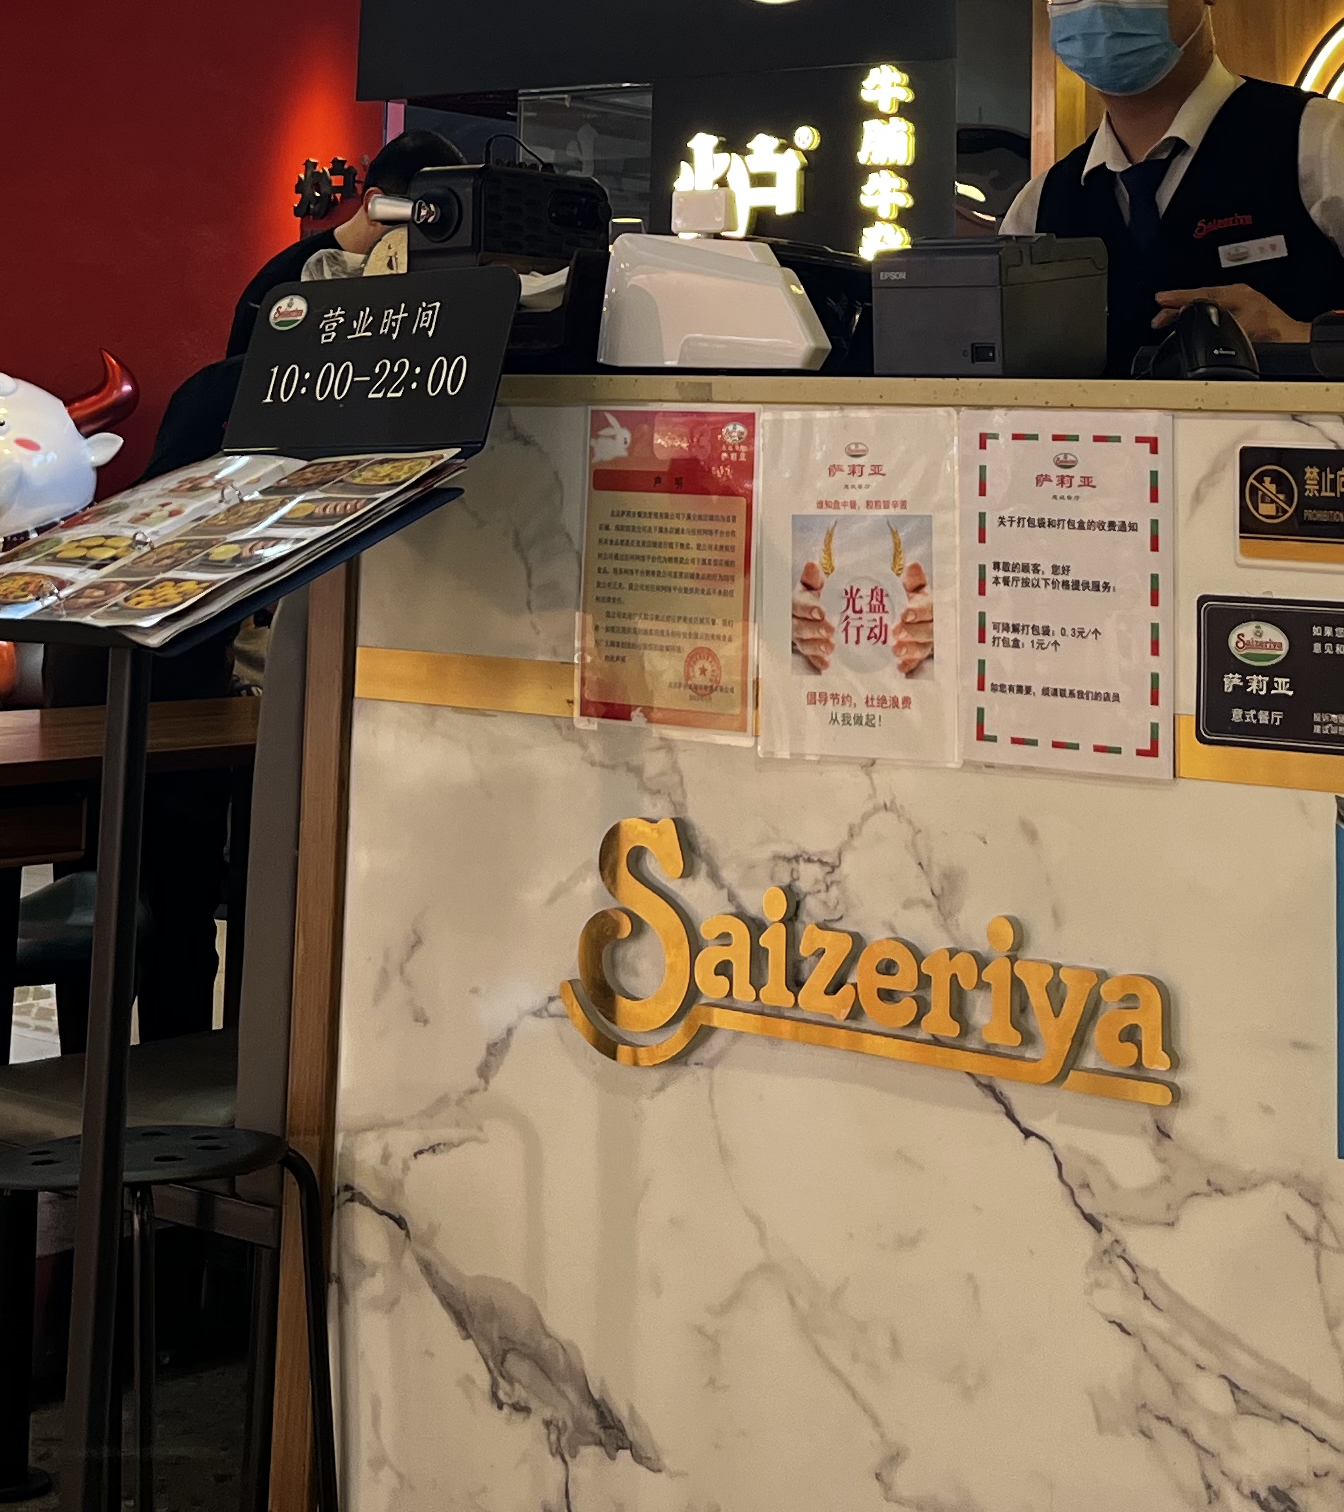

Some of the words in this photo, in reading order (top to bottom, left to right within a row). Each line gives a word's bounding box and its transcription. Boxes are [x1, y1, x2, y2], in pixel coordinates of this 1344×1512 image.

[880, 271, 907, 281] EPSON
[319, 301, 441, 344] 营业时间
[262, 355, 467, 404] 10:00-22:00
[828, 464, 886, 477] 萨莉亚
[1035, 474, 1097, 489] 萨莉亚
[840, 584, 889, 615] 光盘
[840, 615, 889, 646] 行动
[1234, 632, 1284, 652] Saizeriya
[1223, 673, 1294, 696] 萨莉亚
[1231, 708, 1284, 726] 意式餐厅
[561, 817, 1178, 1106] Saizeriya
